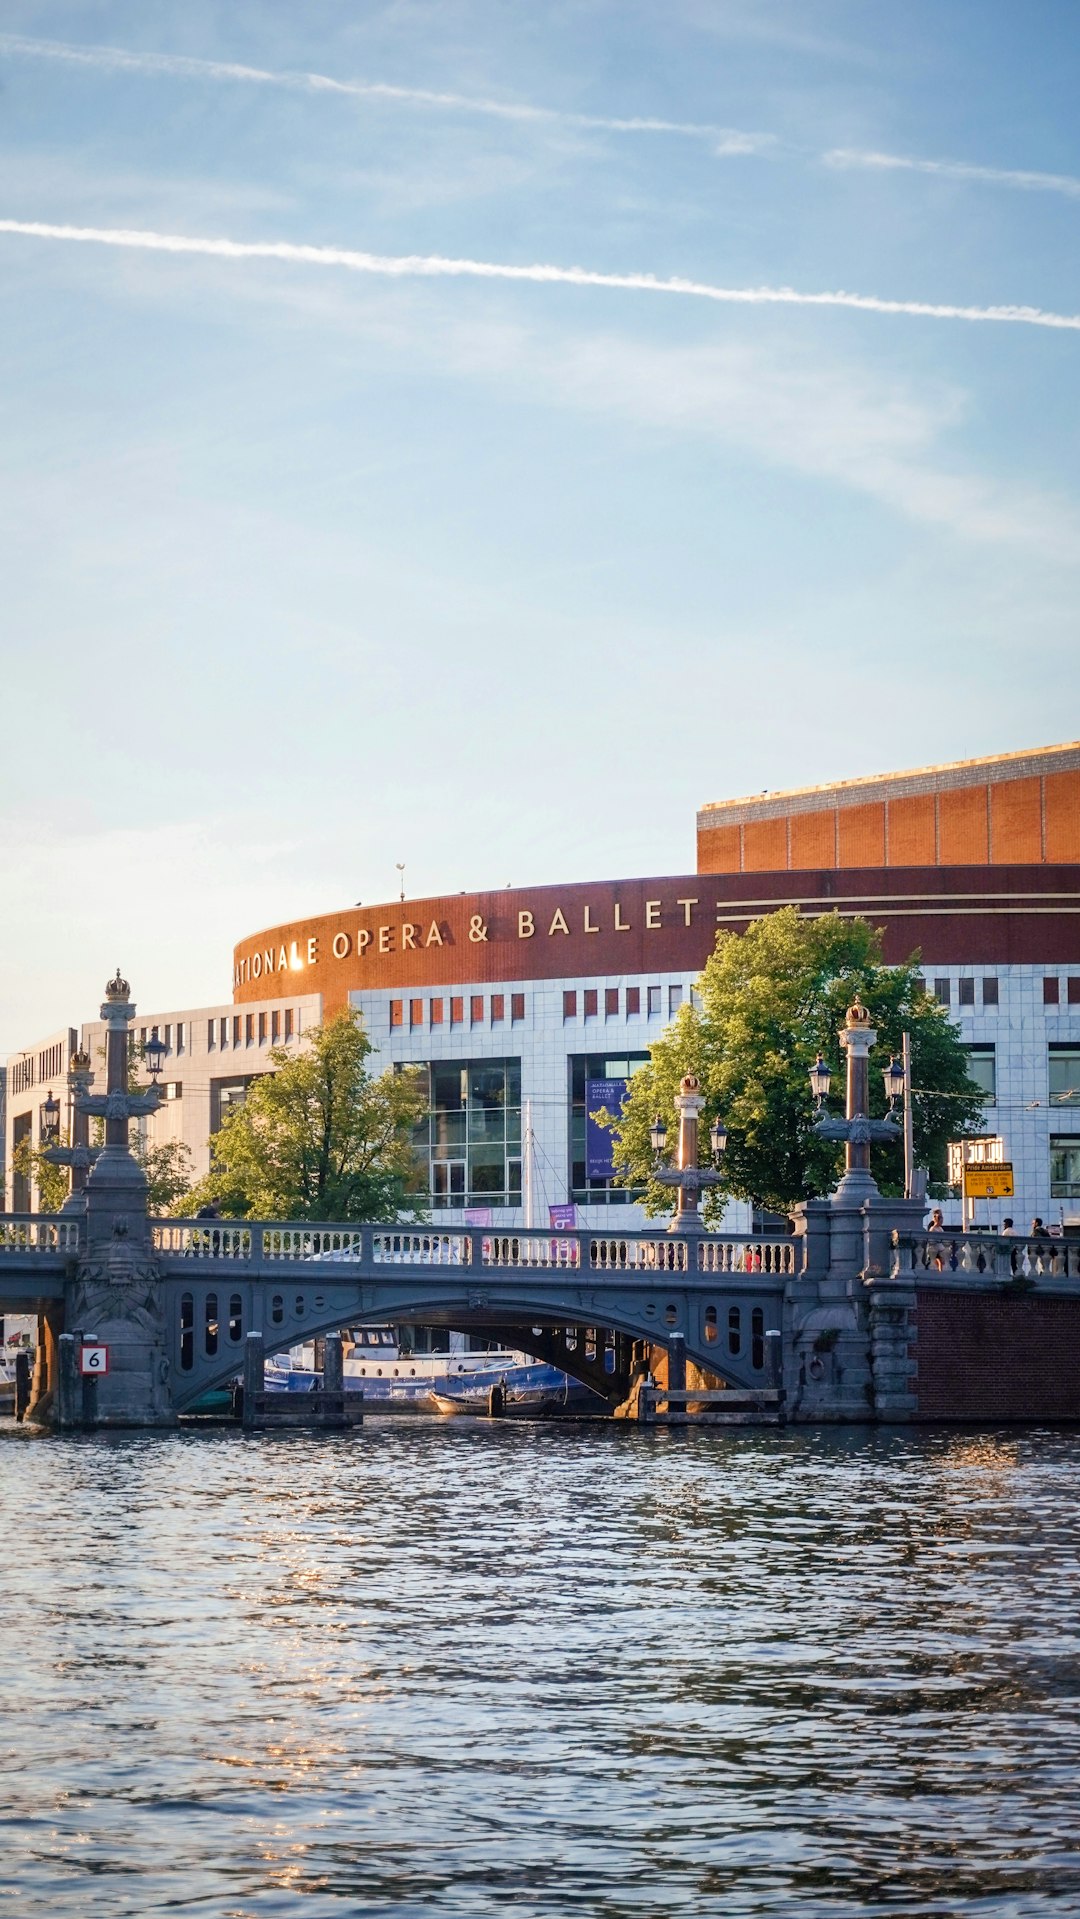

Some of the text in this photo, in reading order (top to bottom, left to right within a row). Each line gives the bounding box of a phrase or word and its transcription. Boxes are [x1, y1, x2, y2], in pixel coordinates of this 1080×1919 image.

[233, 898, 699, 988] ATIONALE OPERA & BALLET
[89, 1352, 99, 1367] 6
